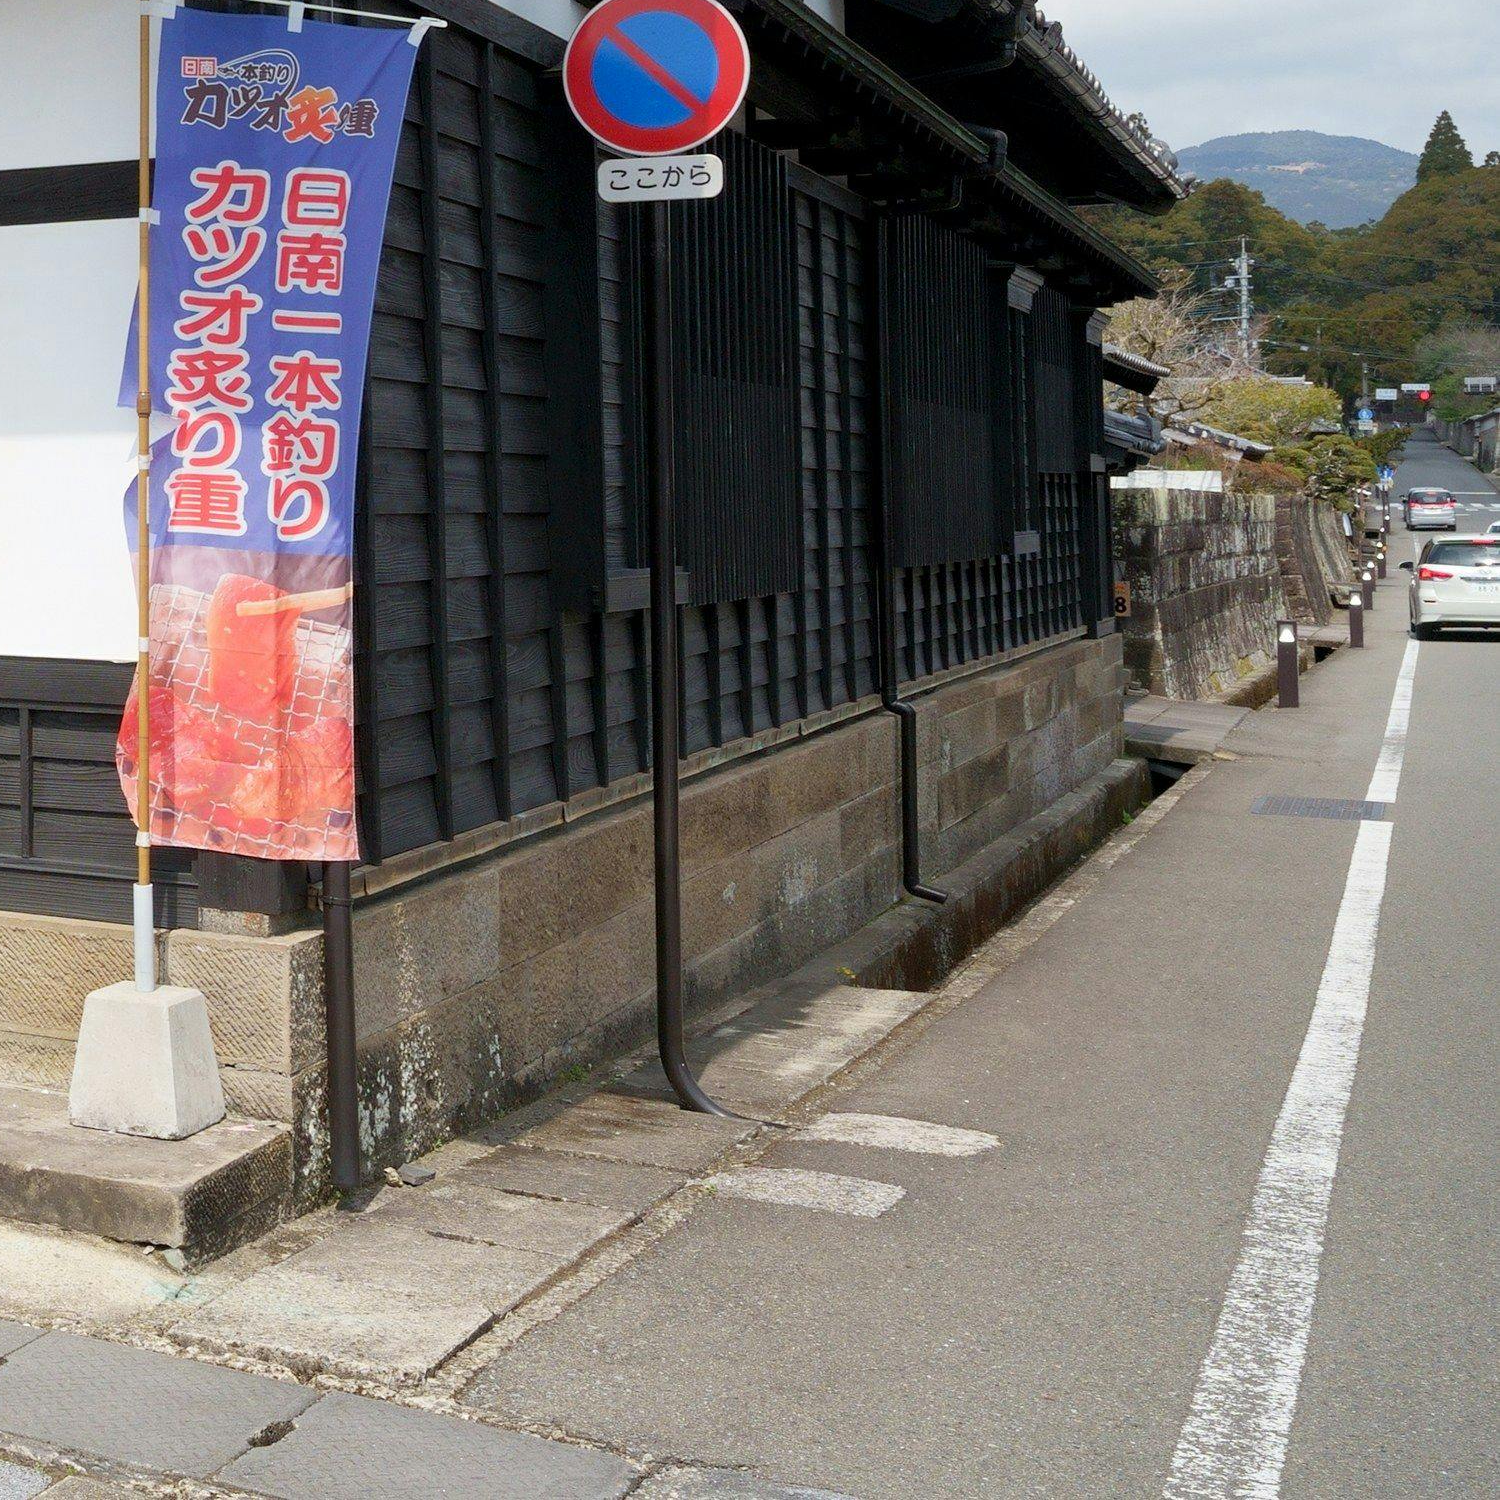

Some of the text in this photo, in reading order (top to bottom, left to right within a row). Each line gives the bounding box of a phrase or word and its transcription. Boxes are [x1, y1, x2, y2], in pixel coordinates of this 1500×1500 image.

[166, 160, 271, 537] カツオ炙り重
[262, 168, 351, 541] 日南一本釣り
[608, 162, 713, 192] ここから
